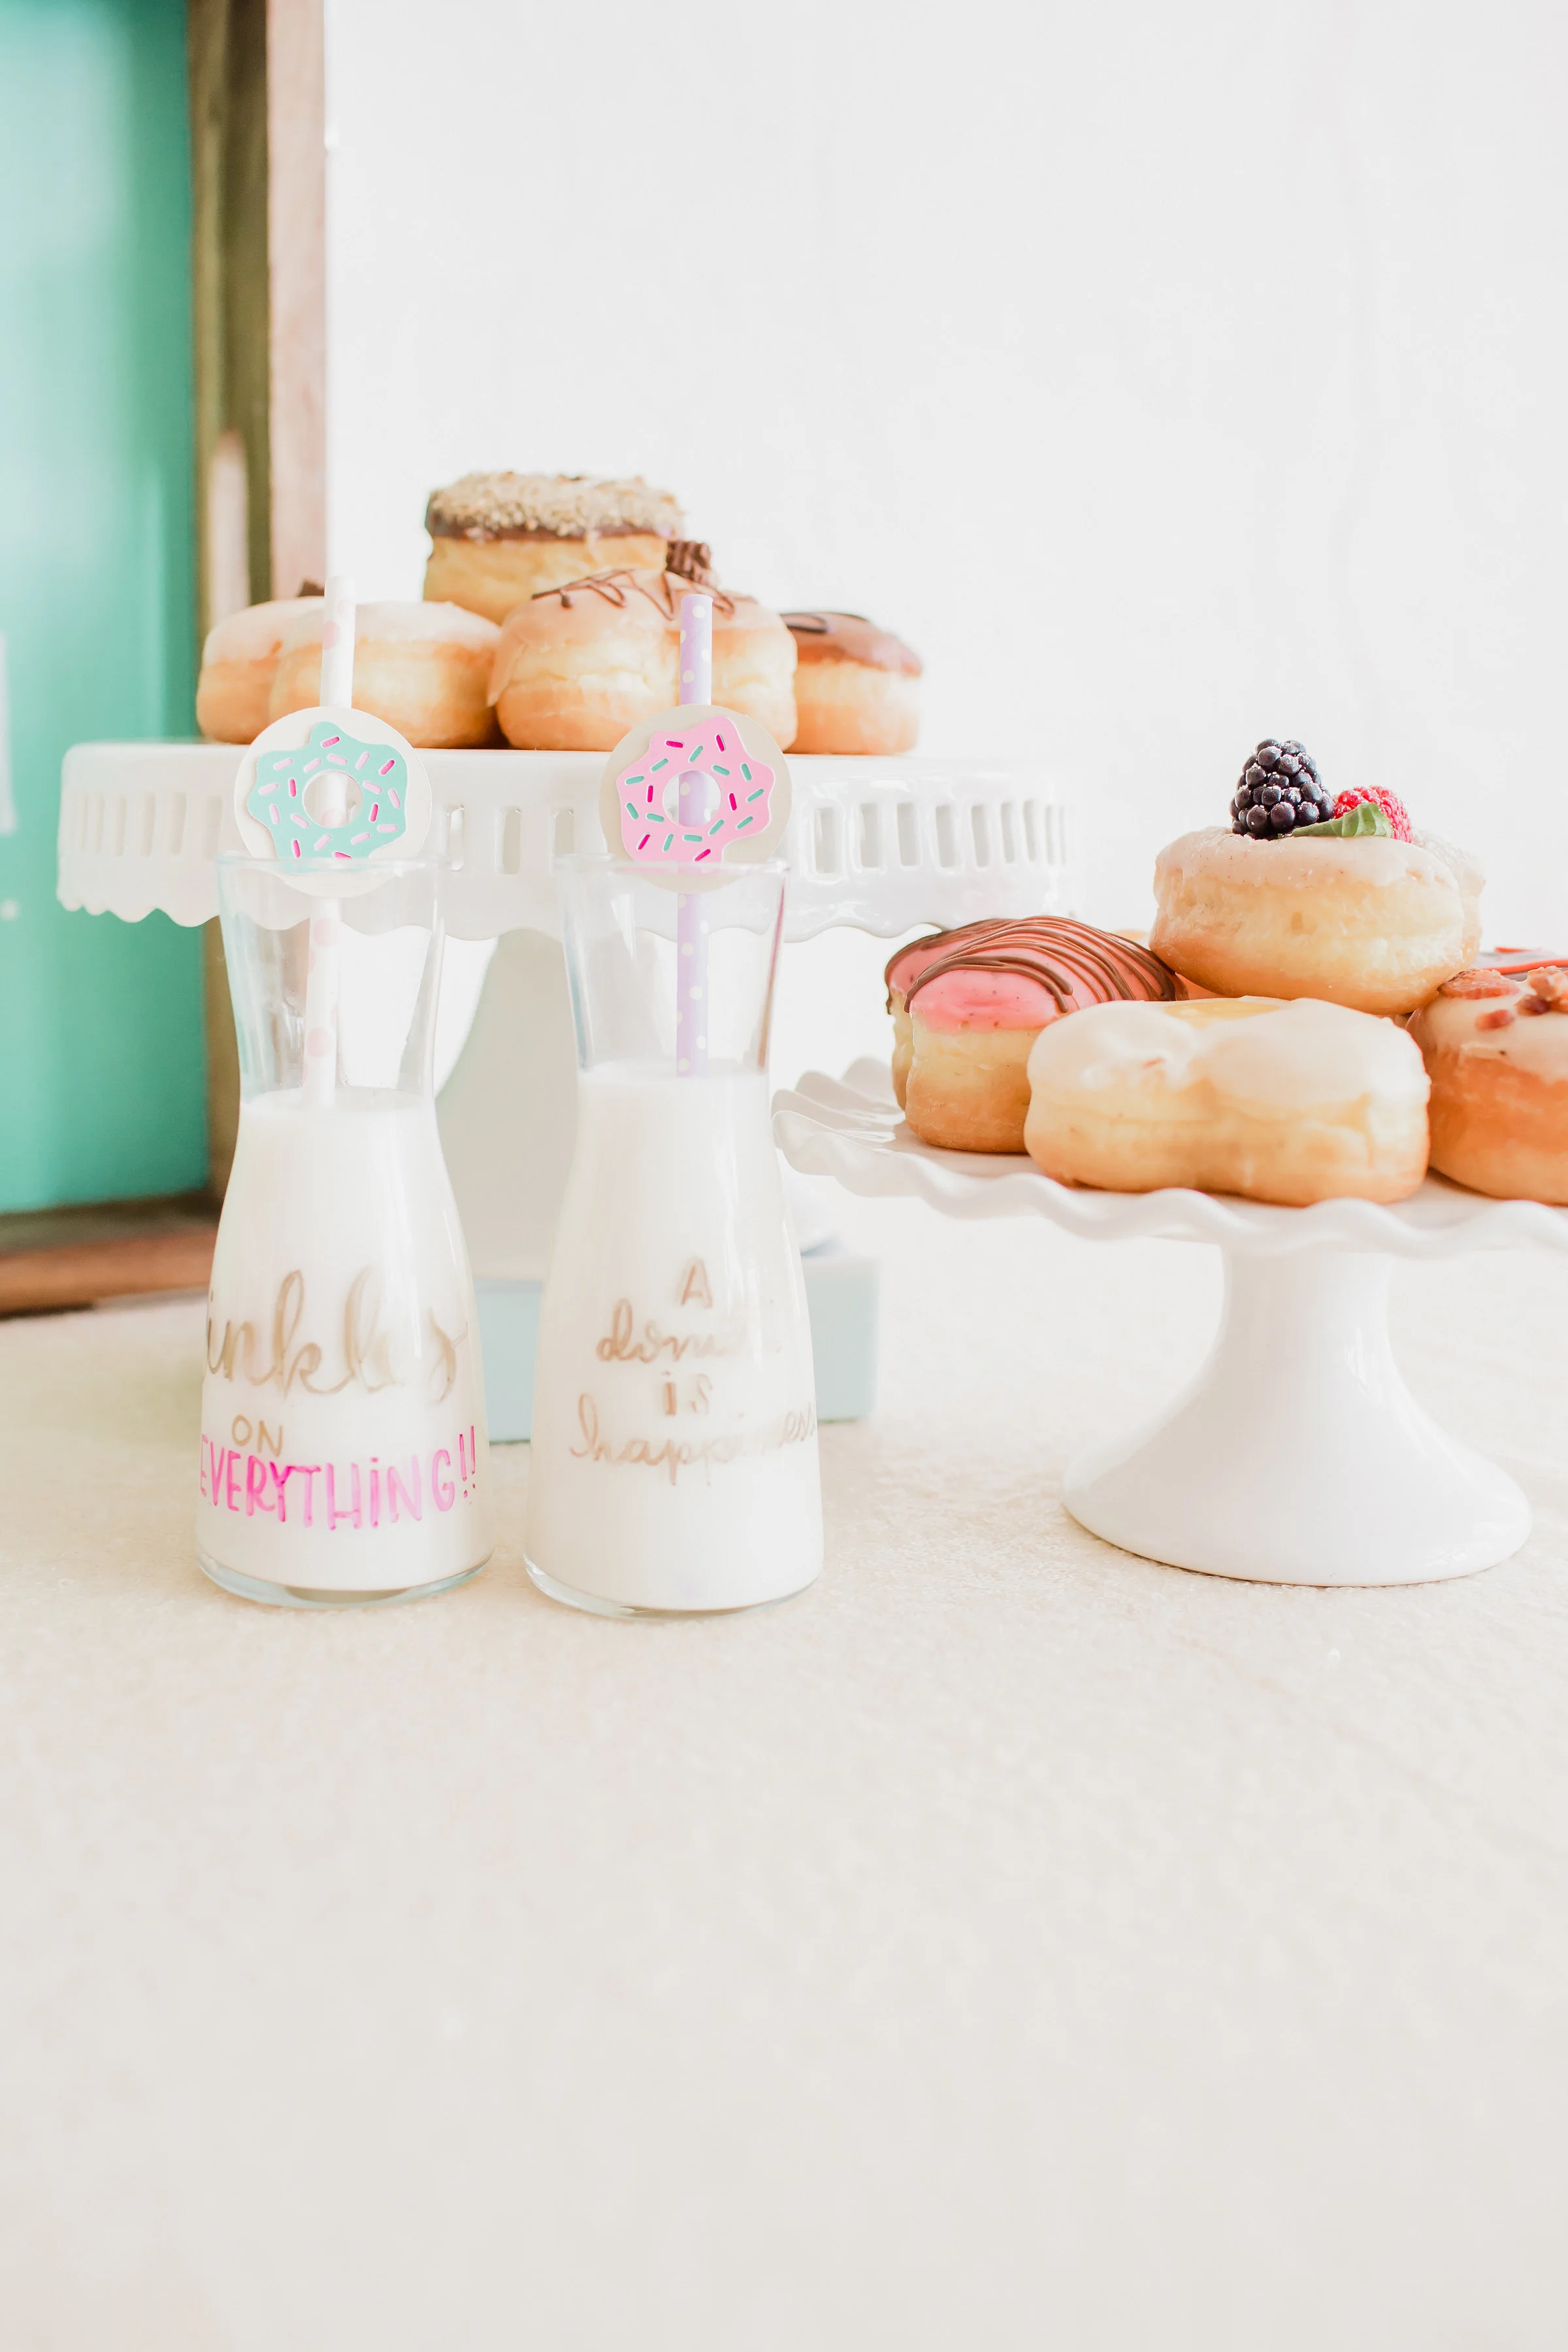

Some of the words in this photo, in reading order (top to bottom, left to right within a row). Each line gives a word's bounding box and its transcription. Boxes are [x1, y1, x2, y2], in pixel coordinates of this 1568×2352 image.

[678, 1256, 713, 1309] A
[595, 1297, 749, 1363] donu
[231, 1414, 283, 1458] ON
[569, 1392, 817, 1487] happiess
